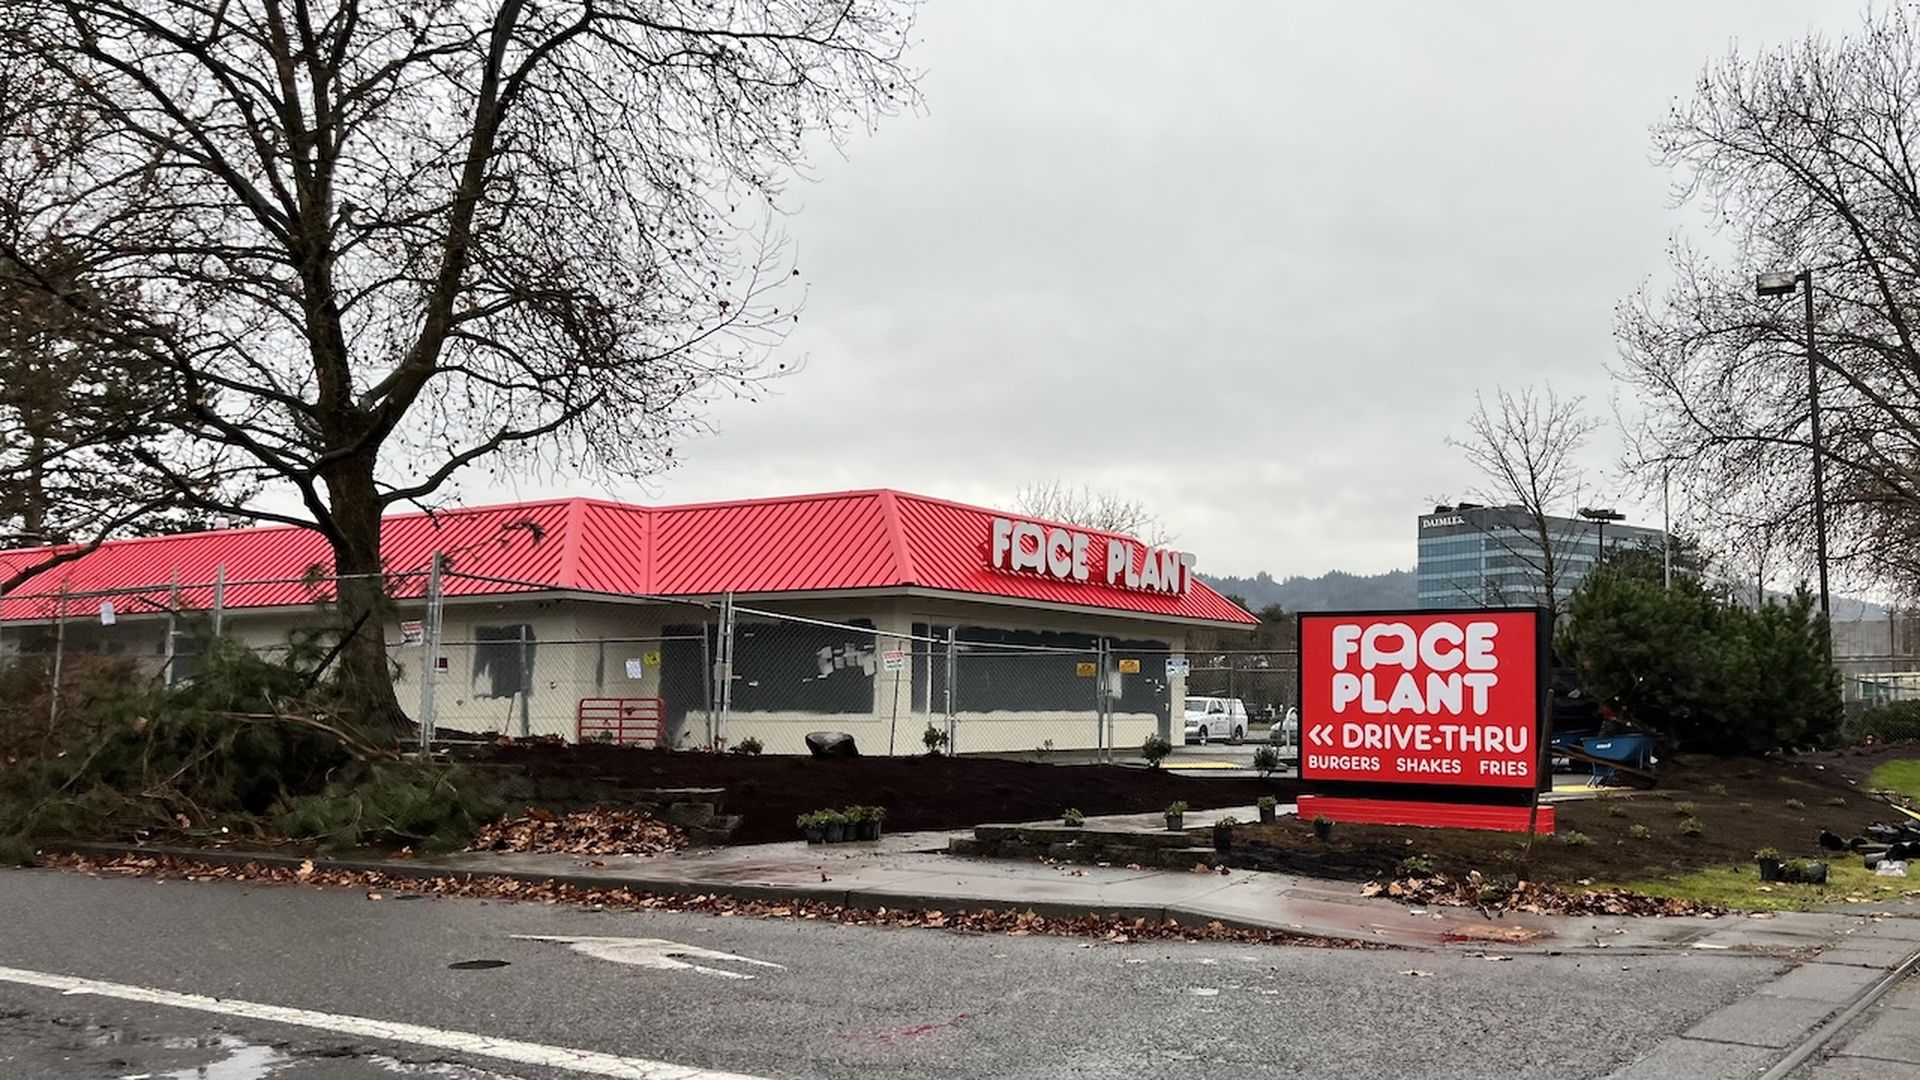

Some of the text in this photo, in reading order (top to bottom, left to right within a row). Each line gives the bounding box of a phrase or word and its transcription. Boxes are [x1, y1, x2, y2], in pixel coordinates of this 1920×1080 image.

[992, 518, 1197, 595] FACE PLANT
[1332, 622, 1499, 671] FACE
[1332, 672, 1499, 716] PLANT
[1342, 723, 1528, 754] DRIVE-THRU
[1308, 754, 1528, 777] BURGERS SHAKES FRIES
